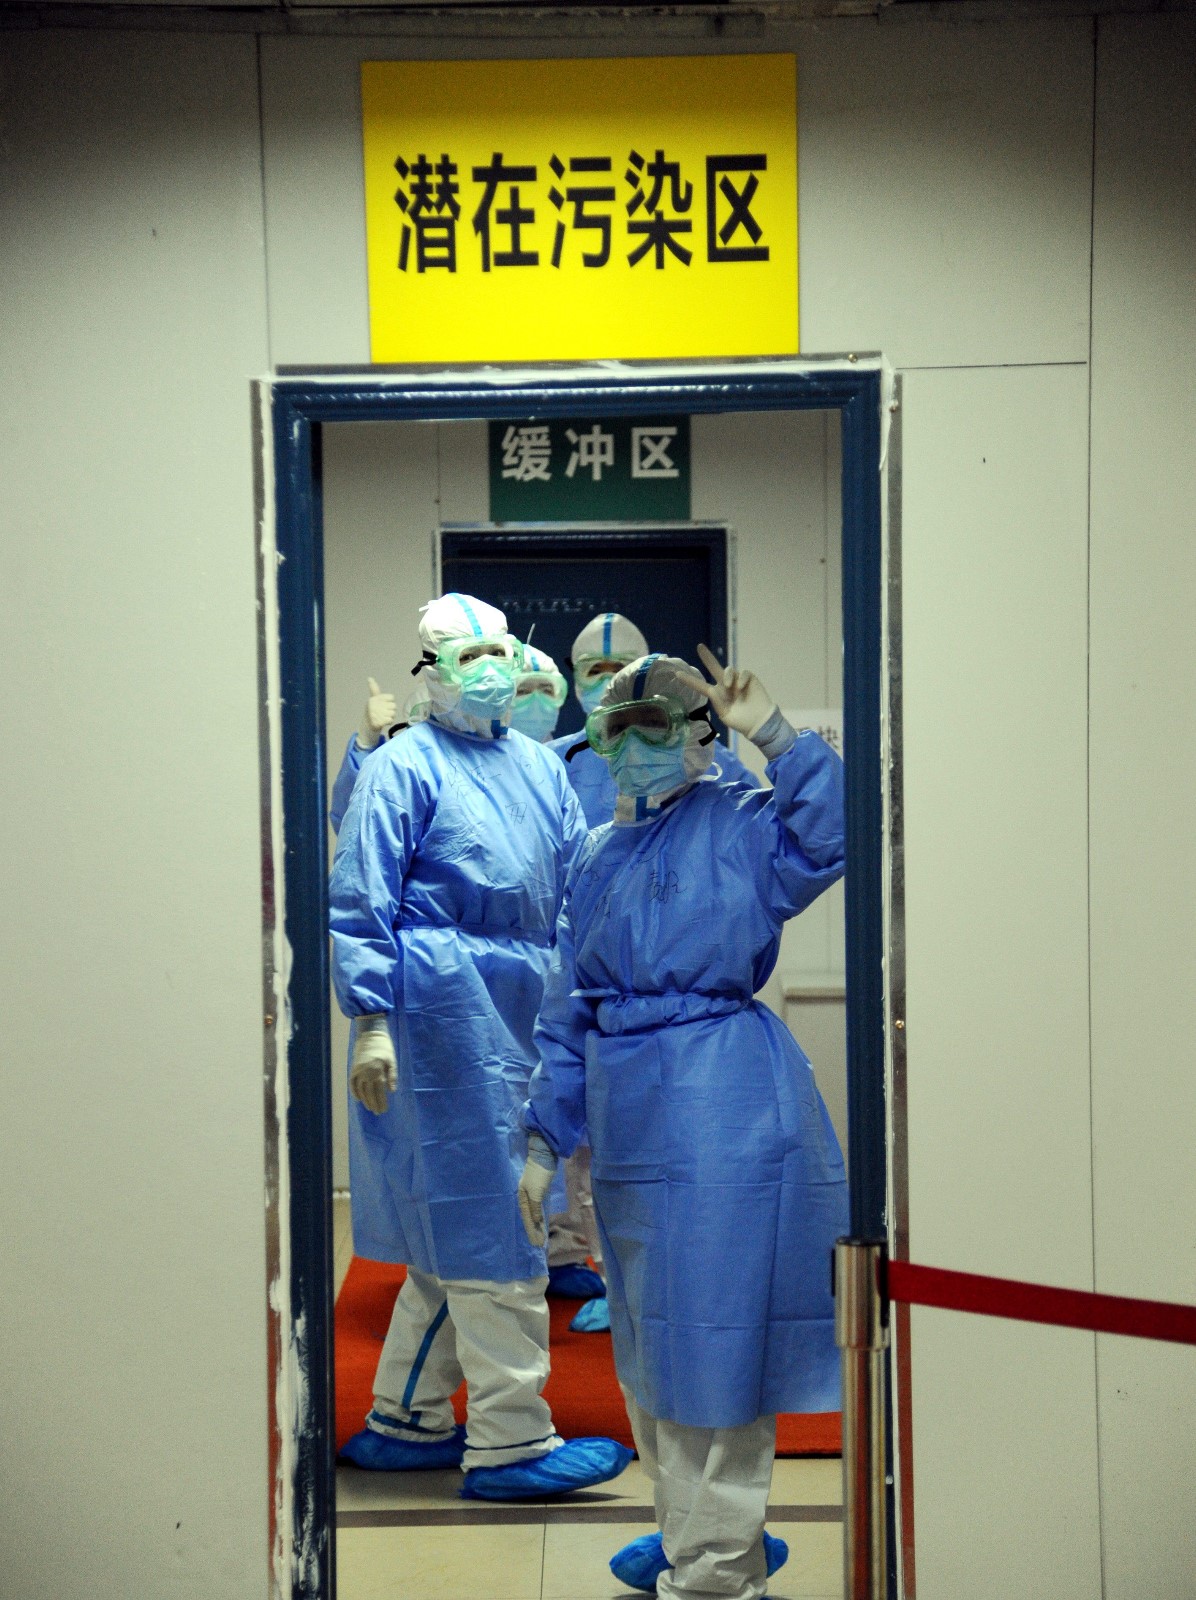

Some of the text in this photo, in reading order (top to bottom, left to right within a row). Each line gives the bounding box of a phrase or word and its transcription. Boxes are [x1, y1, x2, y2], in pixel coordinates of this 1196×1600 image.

[393, 149, 770, 274] 潜在污染区
[501, 424, 680, 481] 缓冲区
